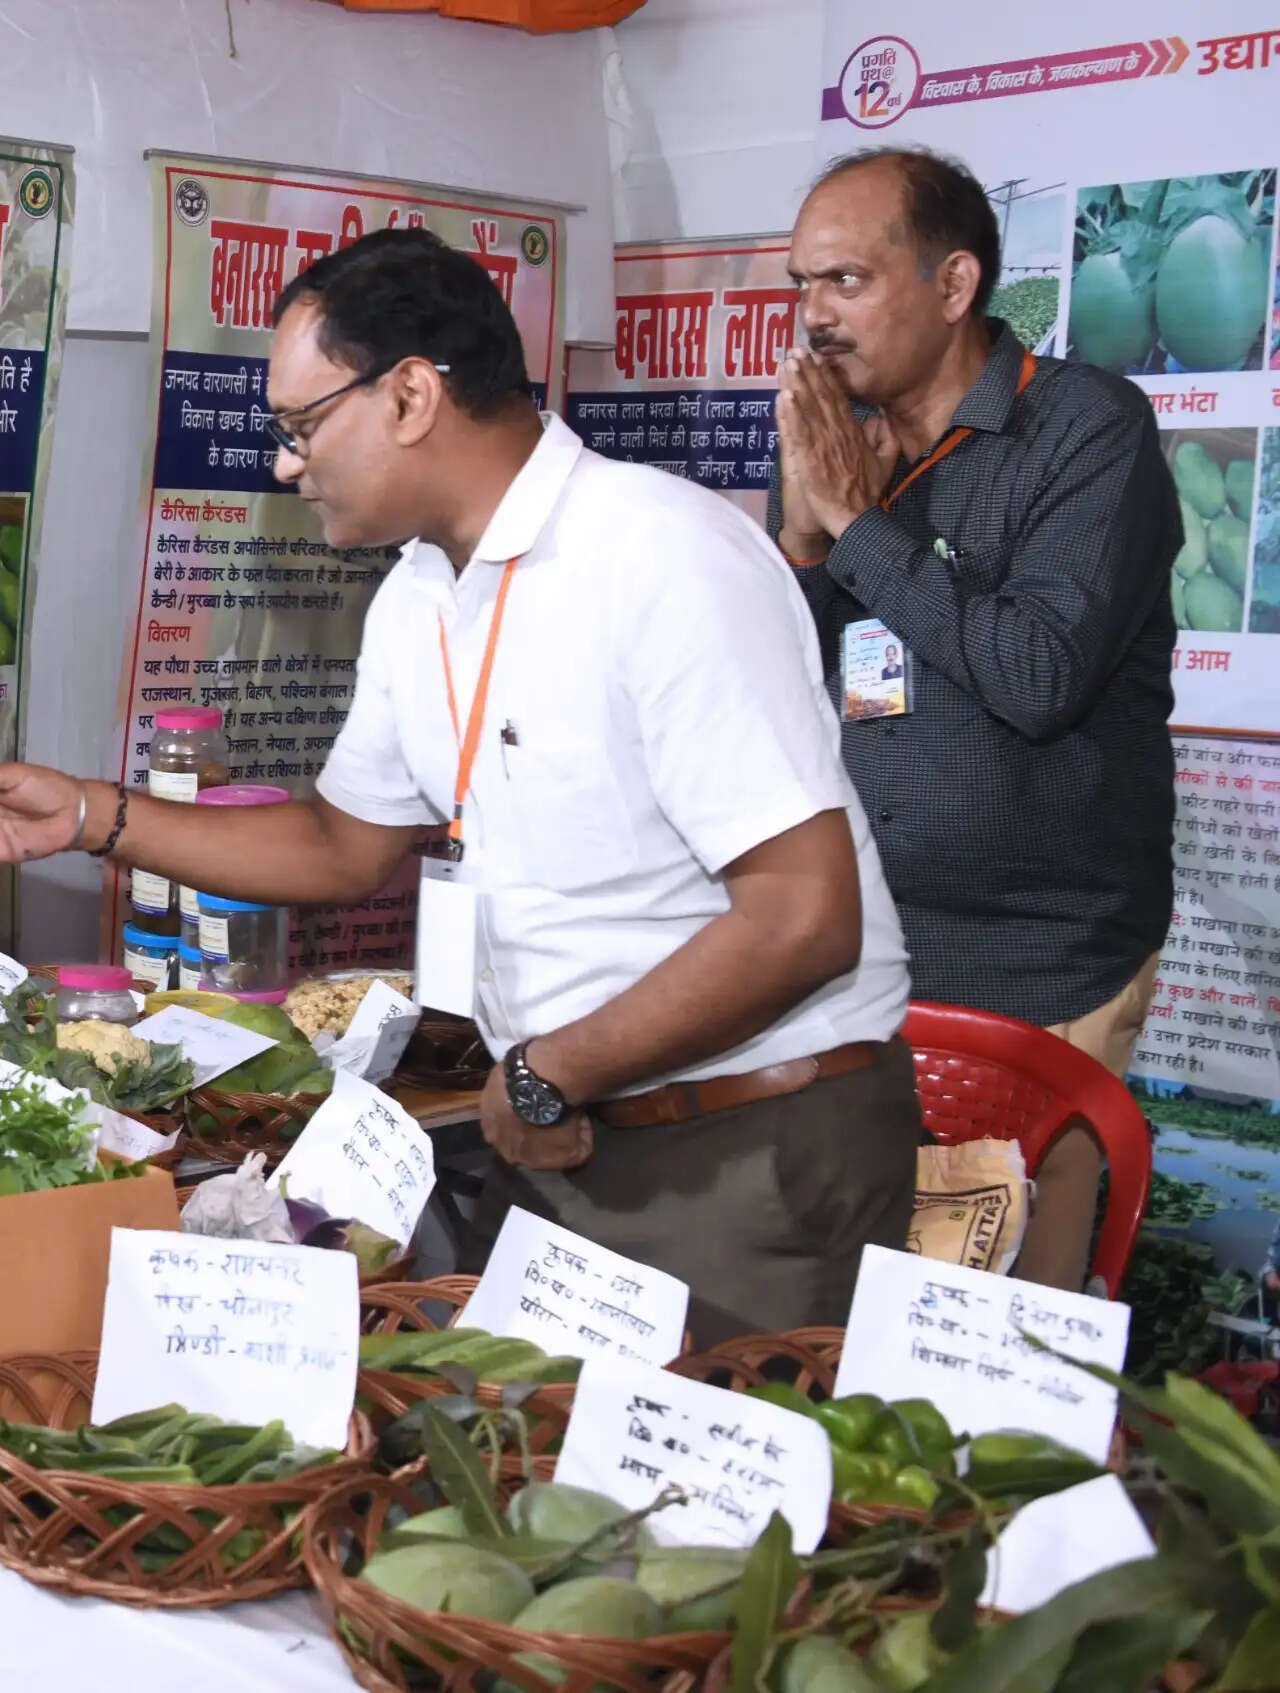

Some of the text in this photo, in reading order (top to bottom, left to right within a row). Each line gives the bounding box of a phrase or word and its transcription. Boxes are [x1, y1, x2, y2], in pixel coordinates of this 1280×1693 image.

[862, 48, 896, 69] प्रगति
[1197, 29, 1280, 75] उद्या
[861, 68, 881, 82] पथ
[985, 70, 1028, 92] विकास
[855, 81, 890, 117] 12
[210, 220, 288, 329] बनारस
[616, 287, 800, 380] बनारस लाल
[20, 357, 32, 392] है
[165, 366, 262, 395] जनपद वाराणसी में
[578, 403, 617, 420] बनारस
[622, 403, 644, 419] लाल
[678, 395, 701, 417] मिर्च
[739, 401, 770, 417] अचार
[1180, 387, 1218, 413] भंटा
[181, 400, 215, 430] विकास
[219, 411, 246, 431] खण्ड
[592, 426, 615, 448] जाने
[620, 426, 644, 448] वाली
[671, 424, 688, 447] की
[690, 432, 709, 448] एक
[715, 426, 743, 448] किस्म
[209, 440, 259, 468] के कारण
[161, 498, 248, 524] कैरिसा कैरंडस
[157, 533, 190, 553] कैरिसा
[175, 562, 240, 581] के आकार के
[224, 590, 237, 608] के
[148, 619, 192, 642] वितरण
[144, 654, 281, 675] यह पौधा उच्च तापमान वाले
[1186, 650, 1230, 671] आम
[281, 680, 317, 698] पश्चिम
[139, 706, 317, 728] पर यह अन्य दक्षिण
[246, 758, 314, 778] और एशिया के
[1152, 1030, 1271, 1059] उत्तर प्रदेश सरकार
